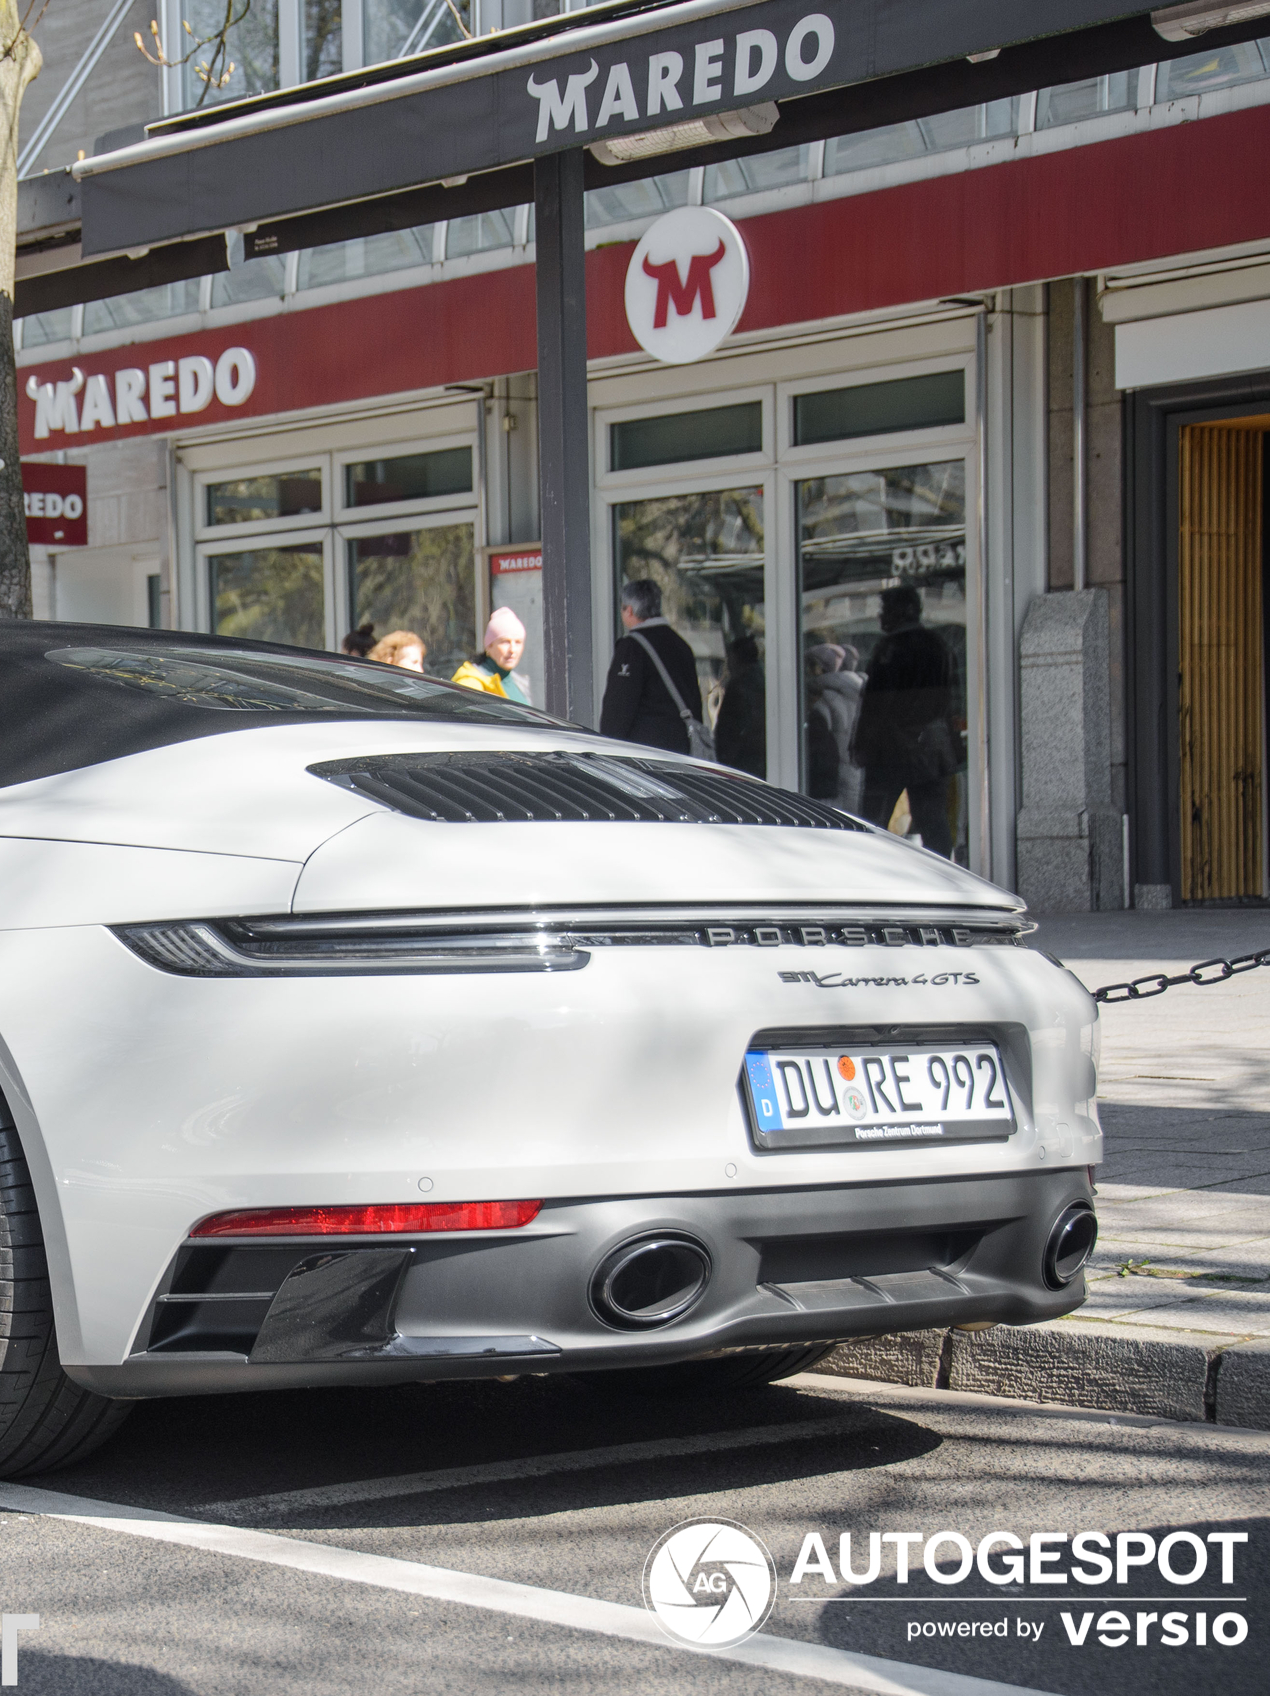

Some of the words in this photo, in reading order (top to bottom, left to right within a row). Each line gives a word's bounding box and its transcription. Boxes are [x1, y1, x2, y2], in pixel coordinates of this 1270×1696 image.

[526, 13, 835, 144] MAREDO
[26, 347, 256, 439] MAREDO
[499, 556, 542, 570] MAREDO
[706, 927, 973, 947] PORSCHE
[816, 972, 908, 988] Carrera
[912, 973, 928, 985] 4
[930, 972, 980, 985] GTS
[775, 1058, 840, 1118] DU
[860, 1054, 923, 1113] RE
[926, 1053, 1005, 1111] 992
[761, 1098, 773, 1117] D
[855, 1126, 884, 1139] Porsche
[882, 1125, 911, 1137] Zentrum
[910, 1123, 943, 1136] Dortmund
